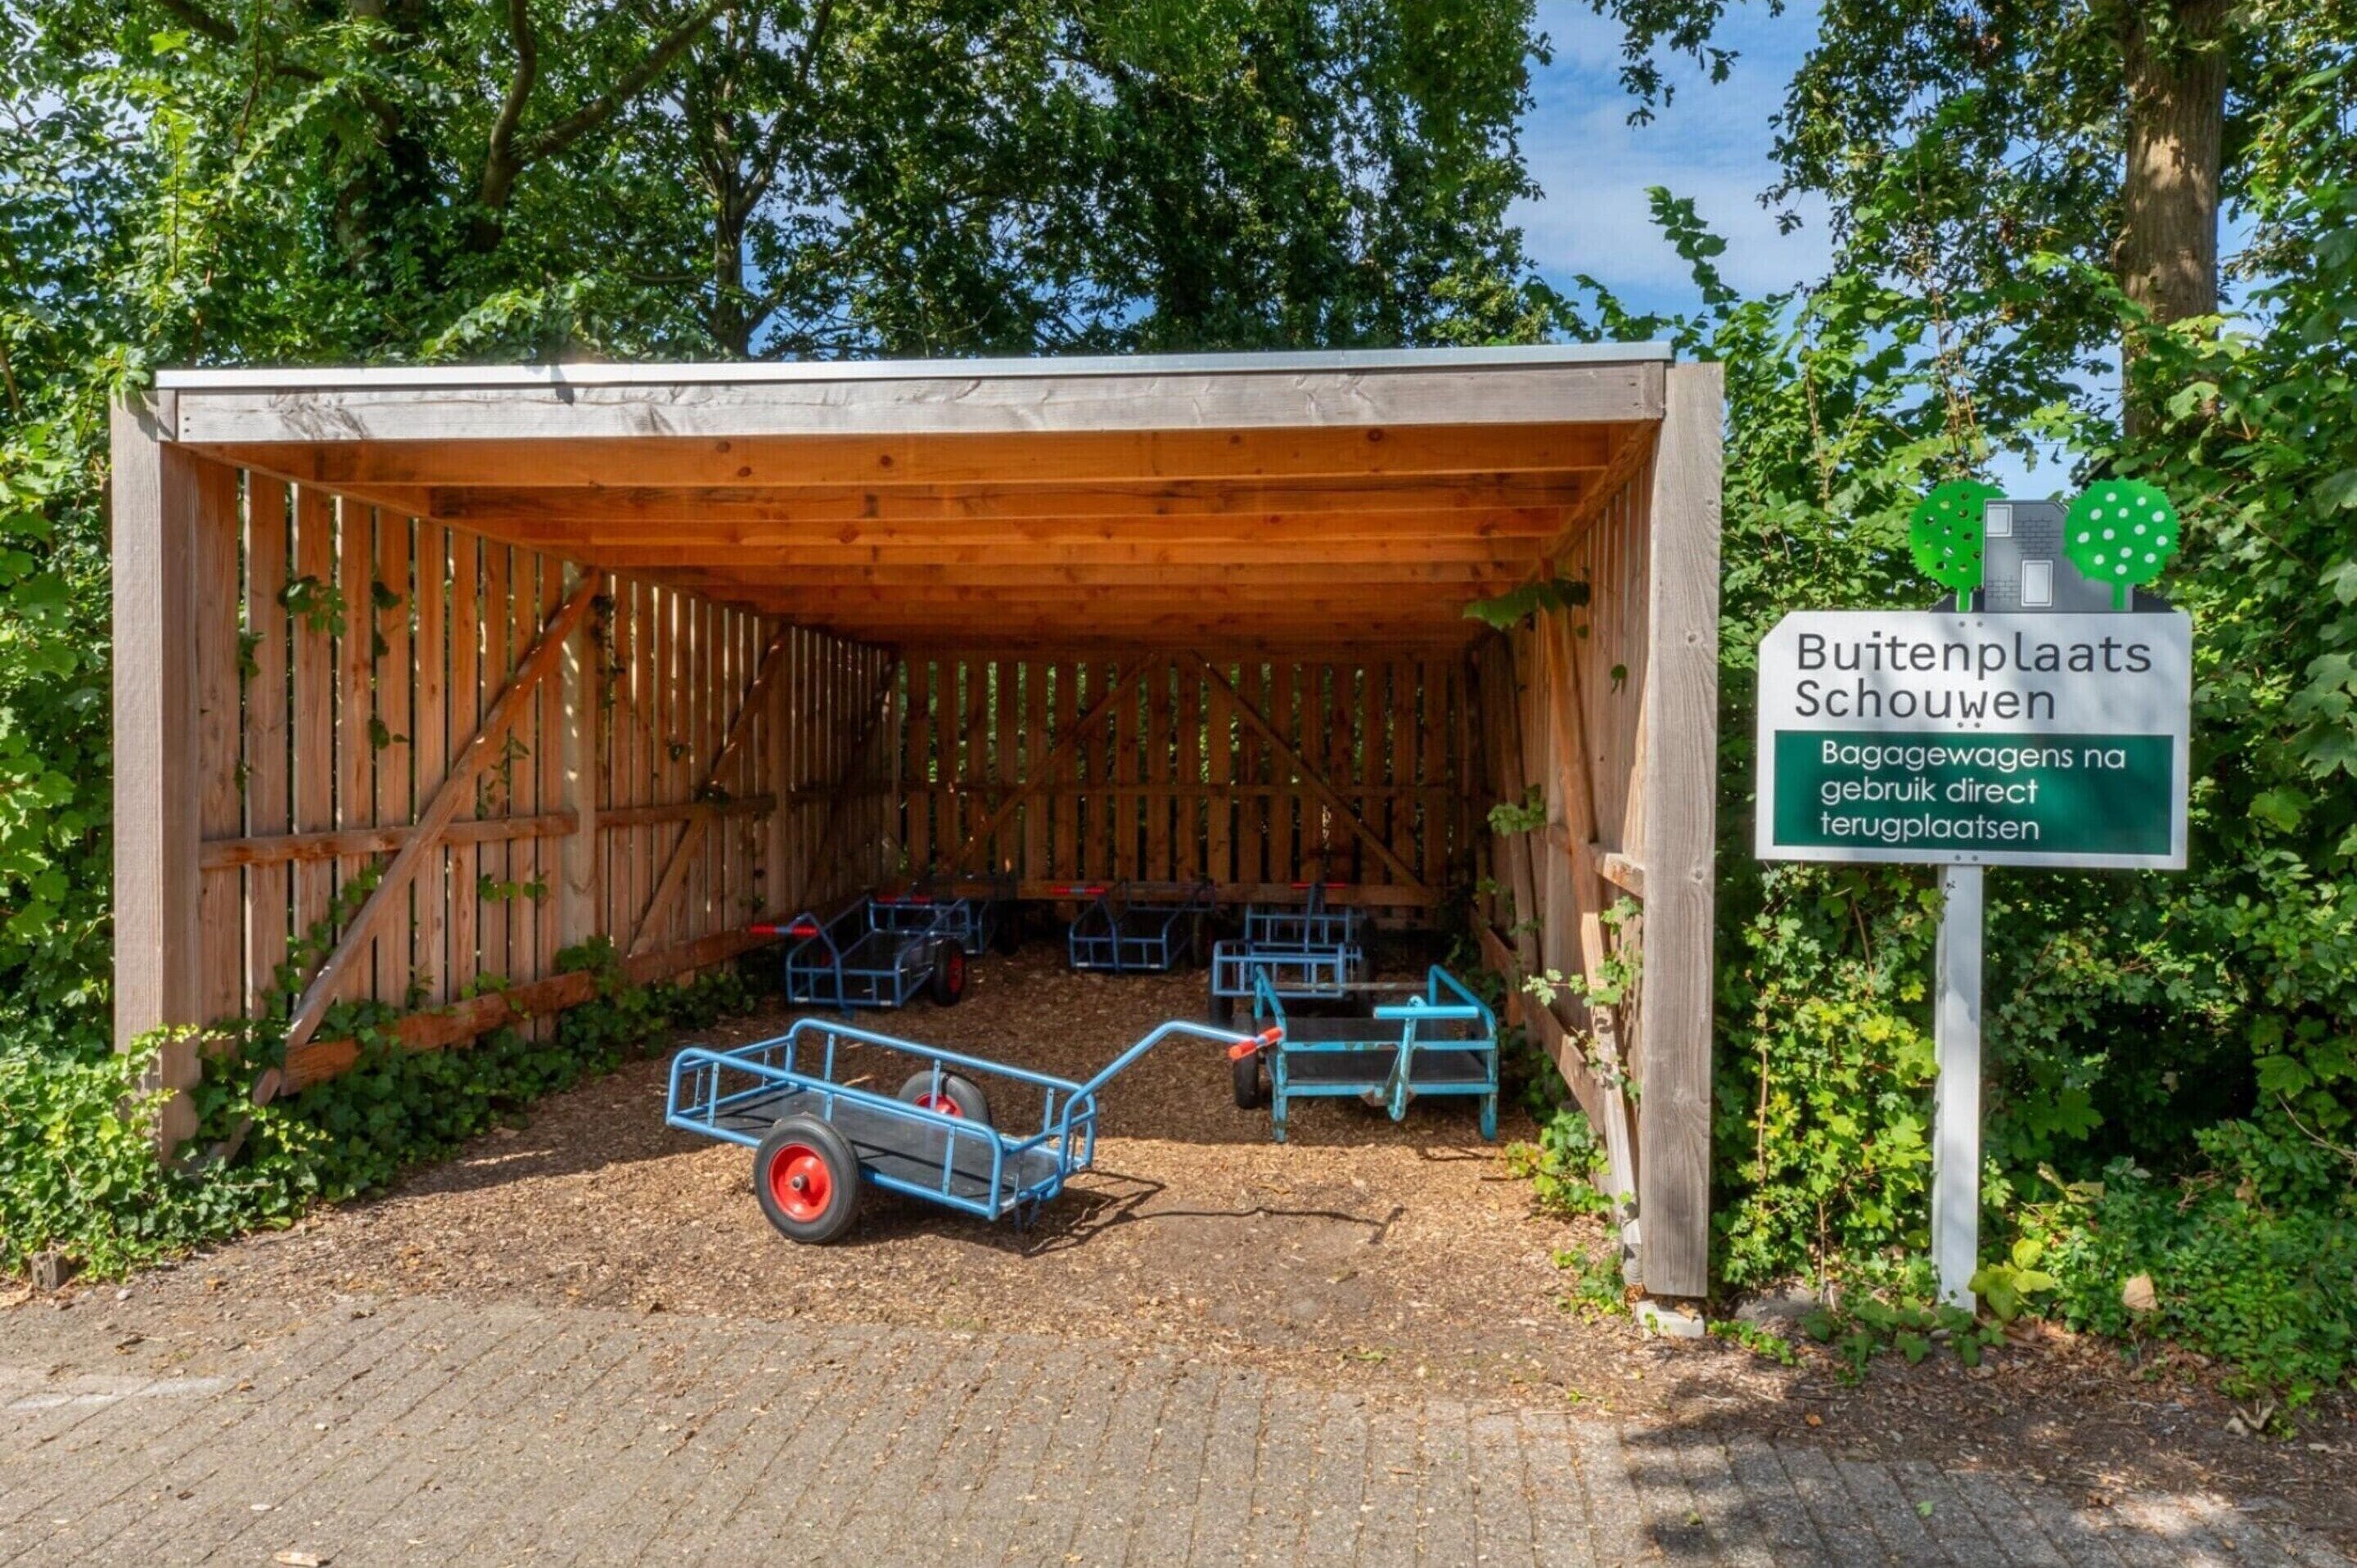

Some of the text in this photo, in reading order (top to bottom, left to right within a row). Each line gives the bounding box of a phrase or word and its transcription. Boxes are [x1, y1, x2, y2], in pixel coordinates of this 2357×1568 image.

[1797, 631, 2152, 680] Buitenplaats
[1795, 678, 2055, 720] Schouwen
[1821, 740, 2125, 772] Bagagewagens na
[1820, 777, 2039, 806] gebruik direct
[1820, 811, 2039, 842] terugplaatsen
